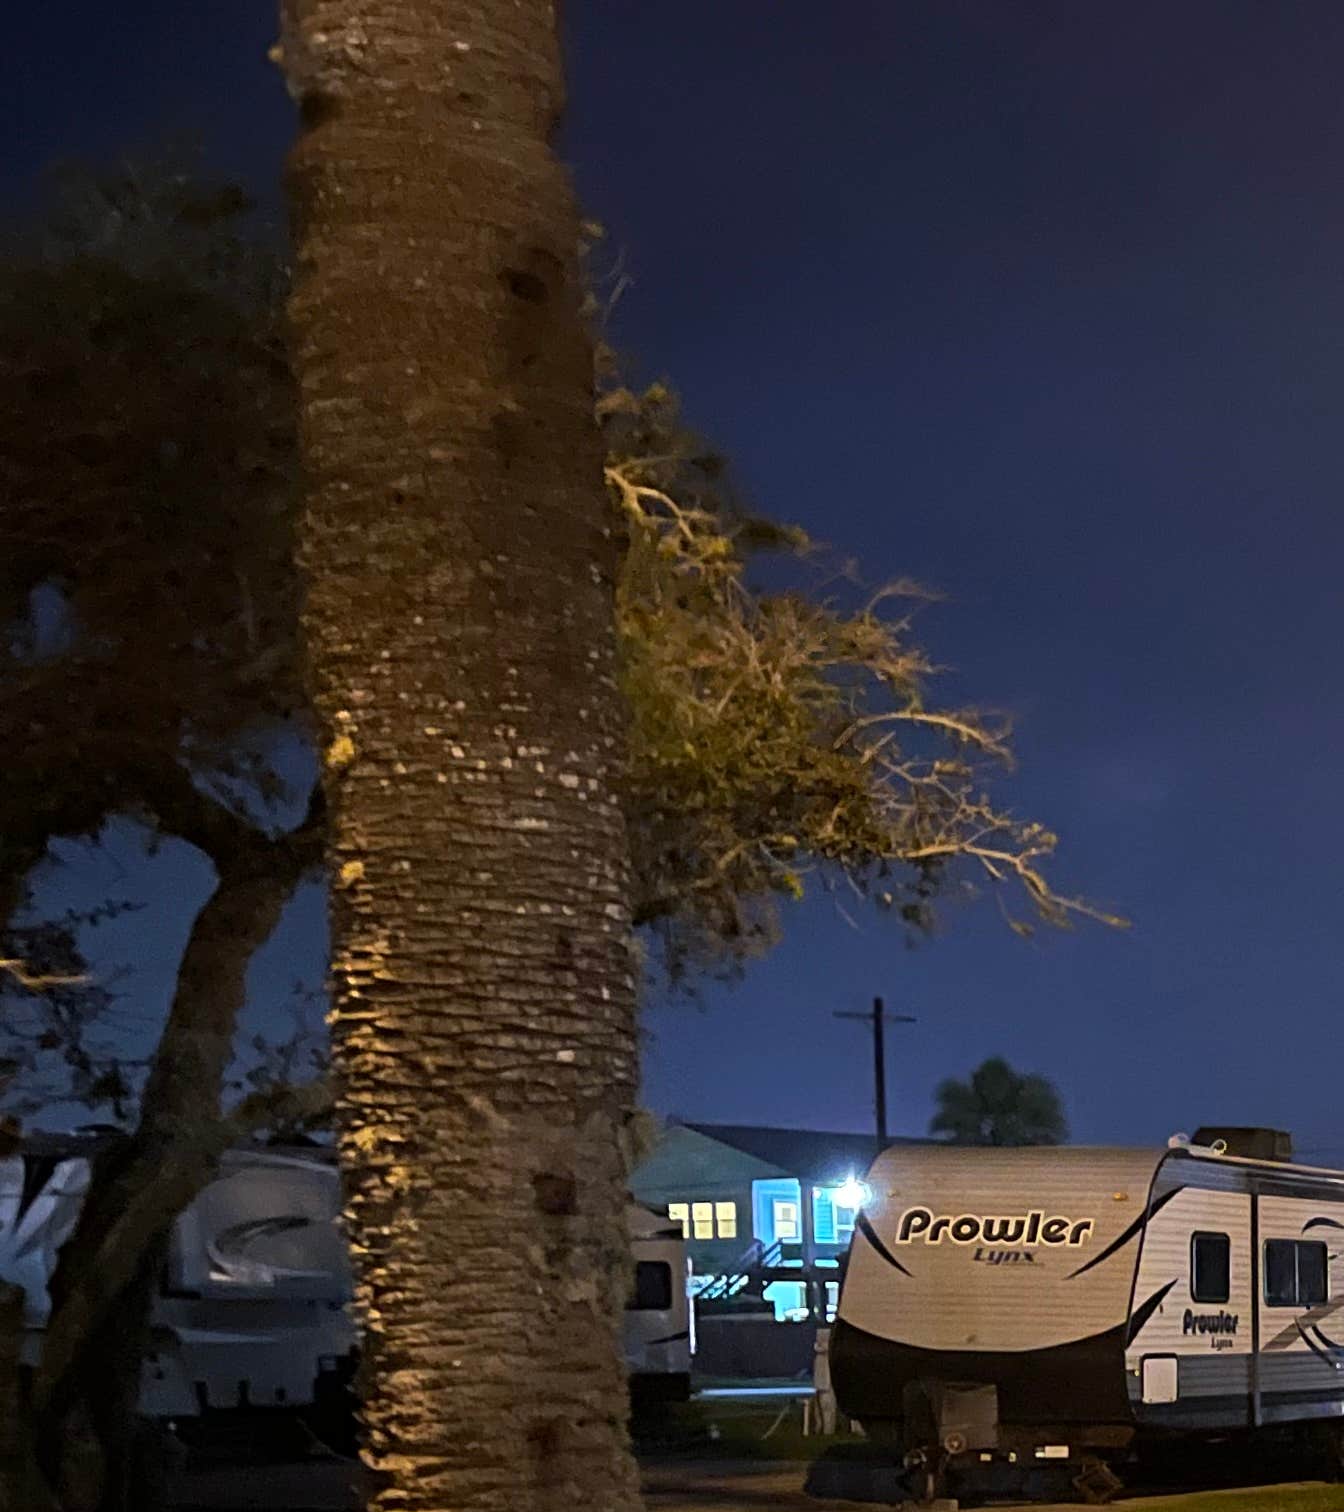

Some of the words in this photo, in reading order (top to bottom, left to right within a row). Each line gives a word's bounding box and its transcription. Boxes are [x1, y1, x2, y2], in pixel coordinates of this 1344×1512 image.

[895, 1206, 1095, 1247] Prowler
[973, 1247, 1039, 1266] Lynx
[1183, 1308, 1239, 1335] Prowler
